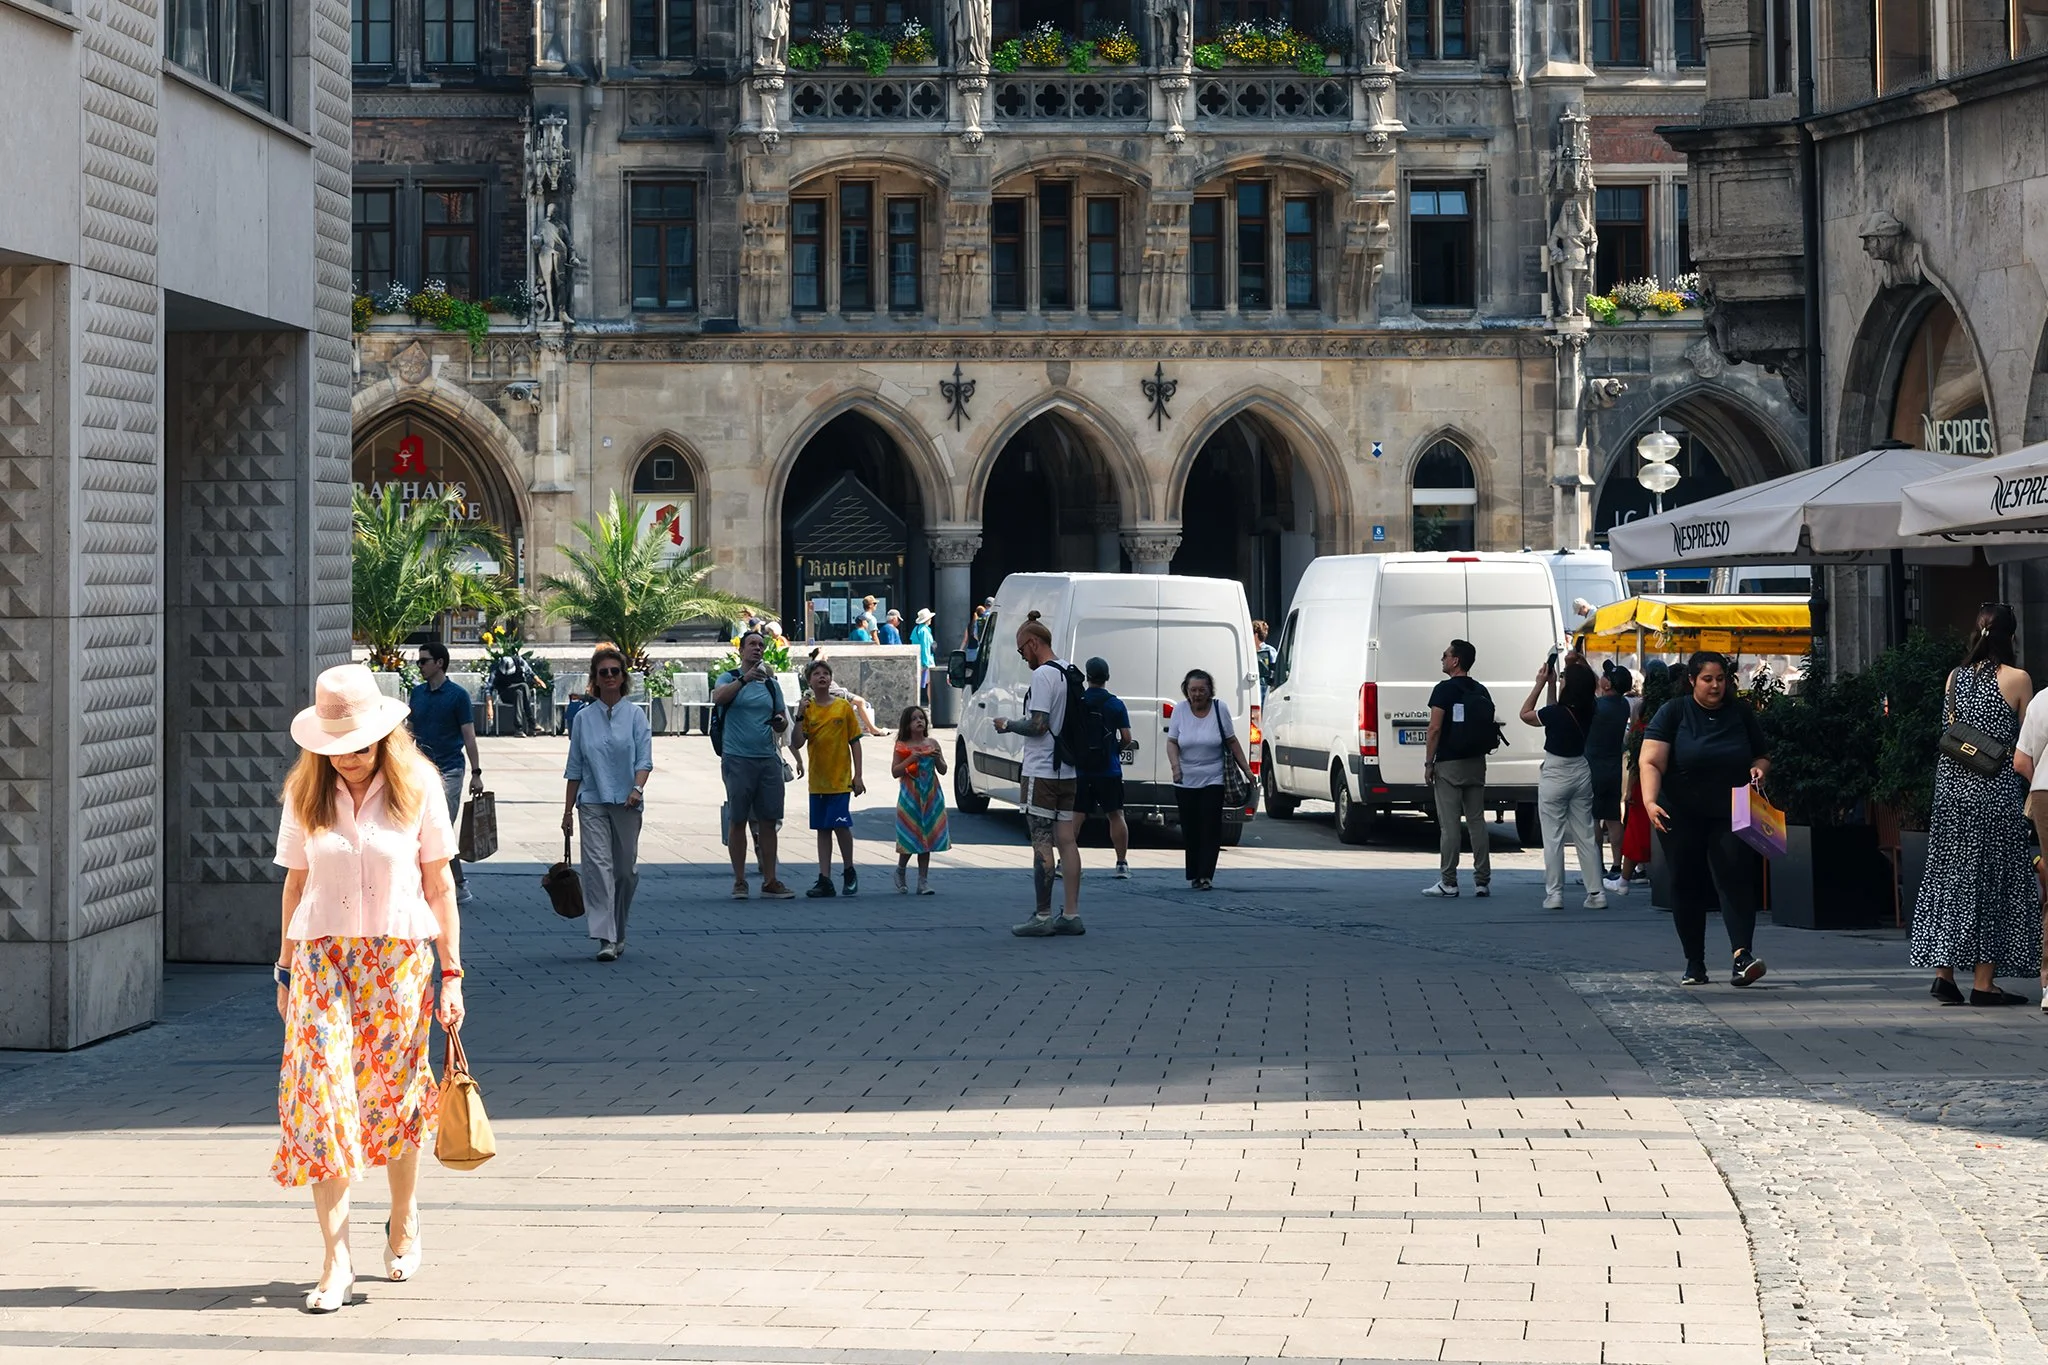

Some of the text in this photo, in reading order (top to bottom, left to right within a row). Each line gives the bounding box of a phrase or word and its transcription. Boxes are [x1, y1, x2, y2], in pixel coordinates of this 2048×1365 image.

[1921, 413, 1994, 455] NESPRES
[1990, 475, 2048, 516] NESPRE
[1670, 521, 1730, 558] NESPRESSO
[807, 559, 891, 577] Ratskeller
[1405, 731, 1412, 741] M
